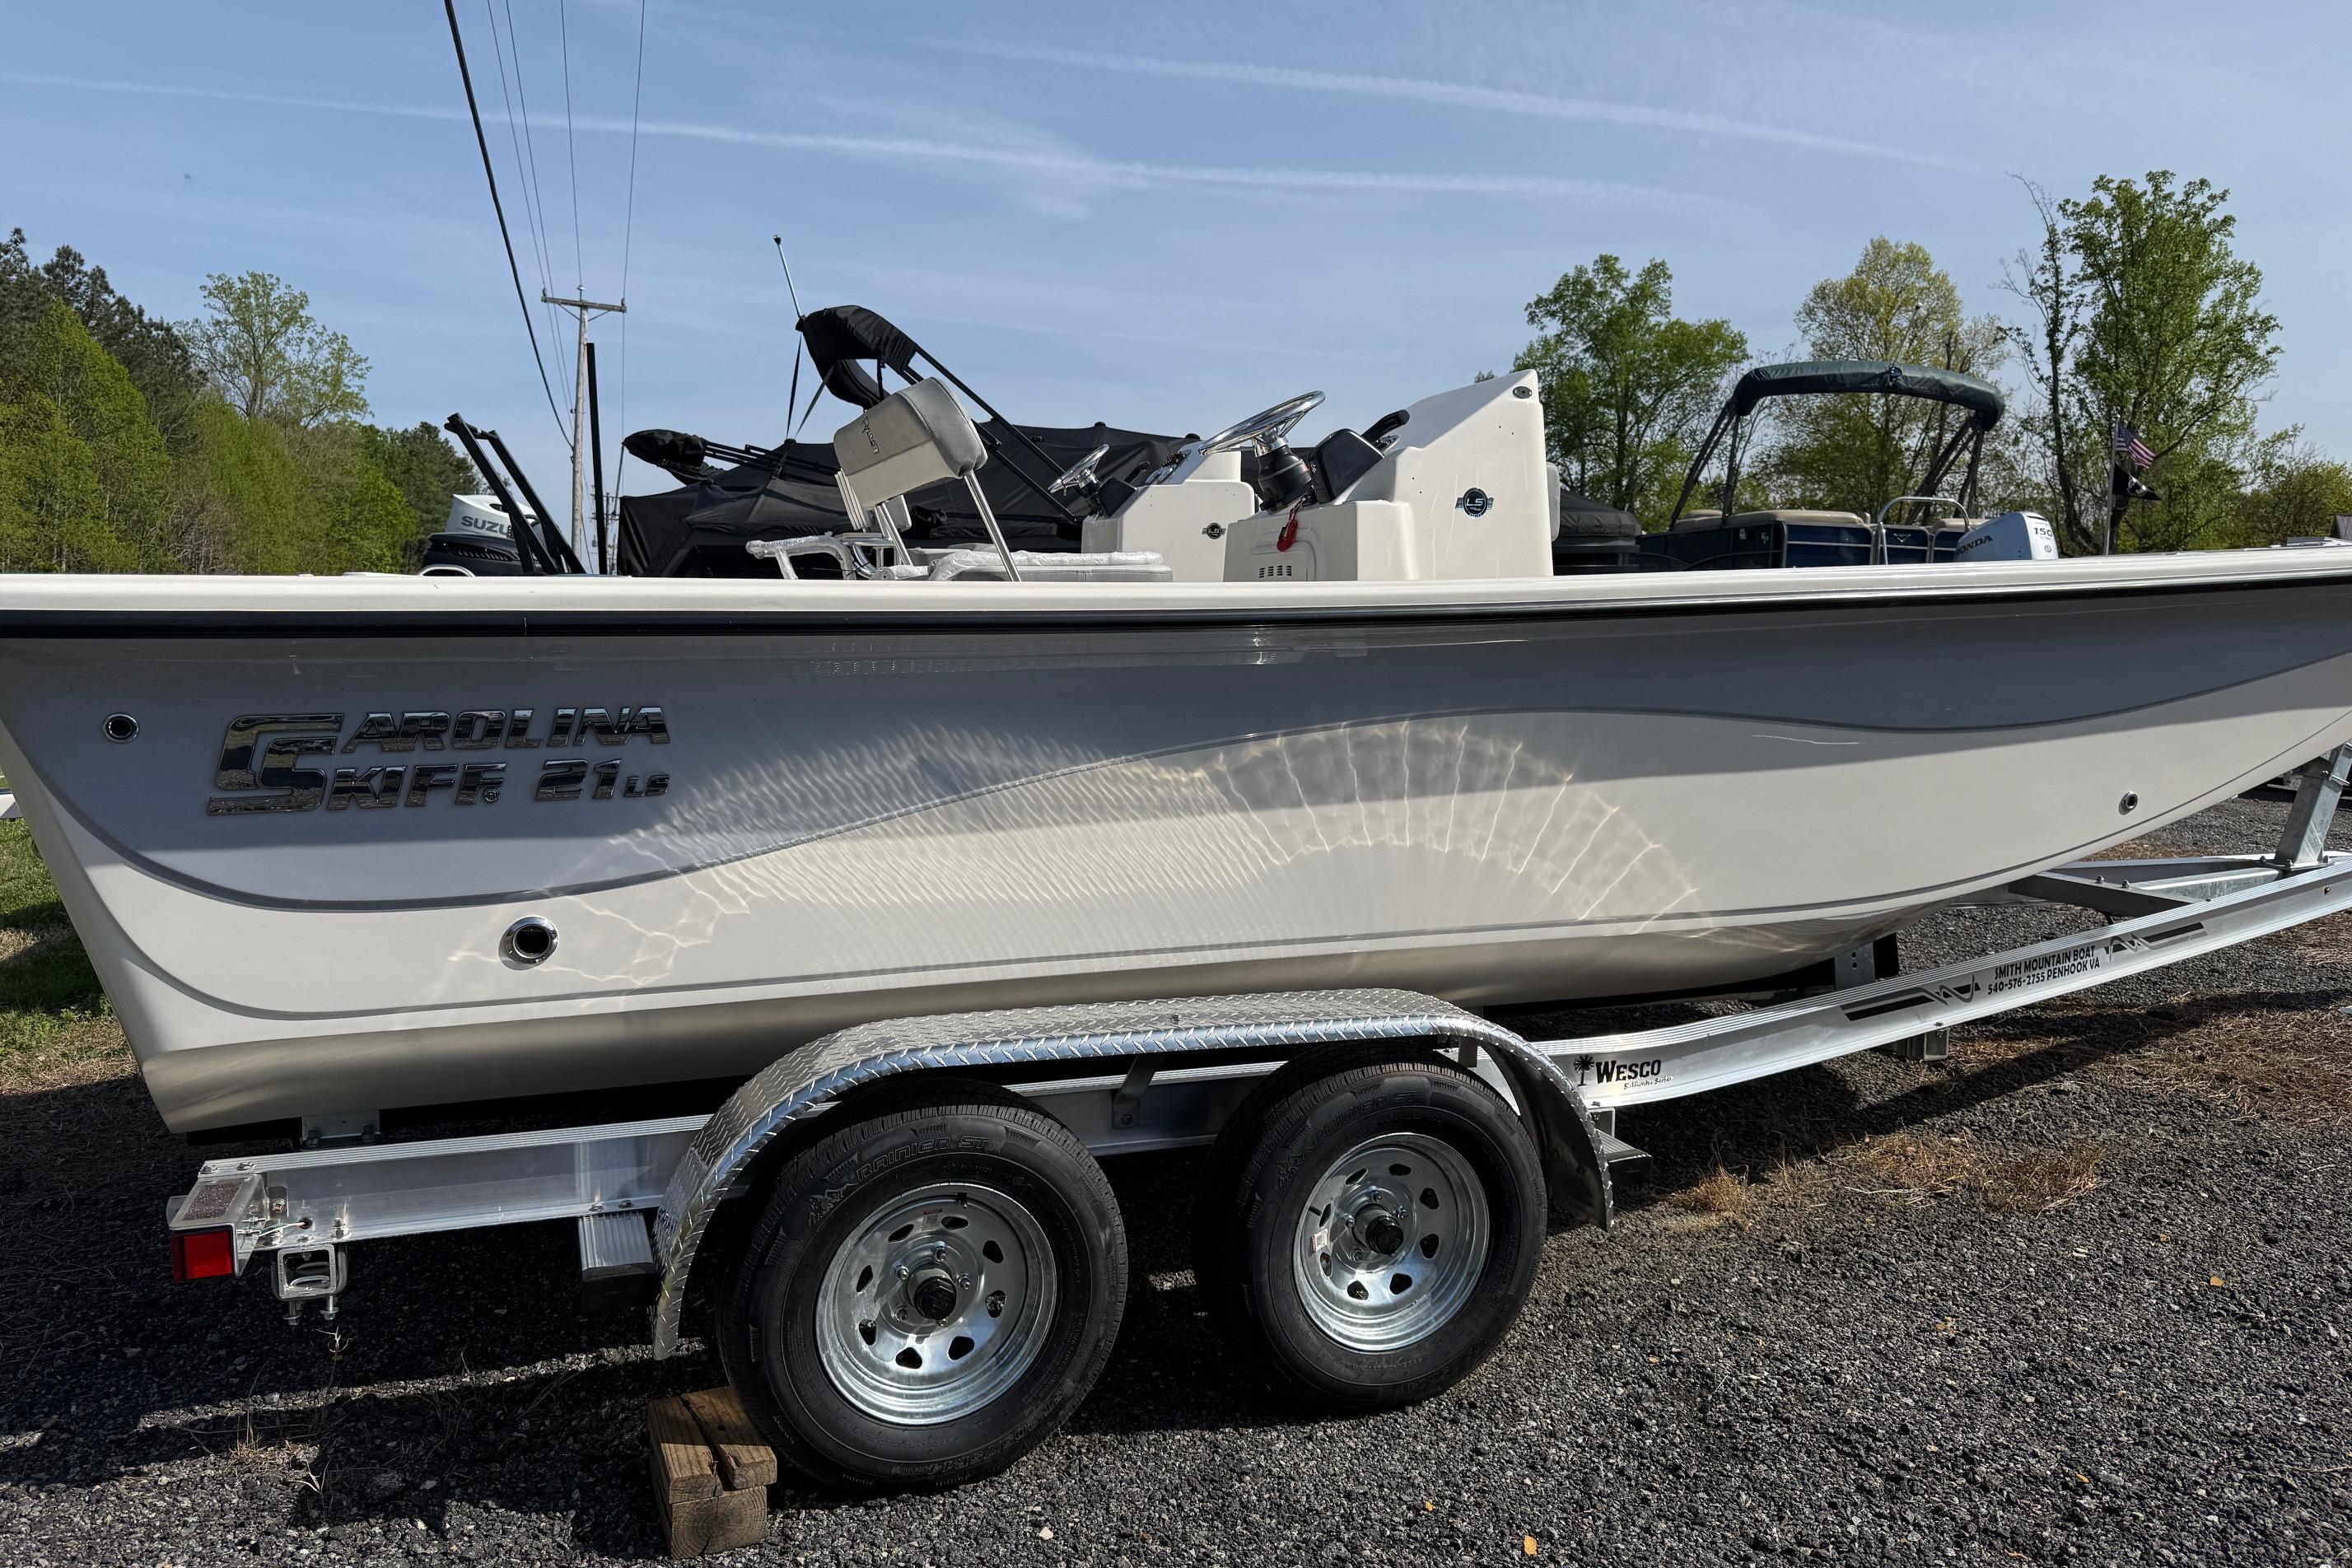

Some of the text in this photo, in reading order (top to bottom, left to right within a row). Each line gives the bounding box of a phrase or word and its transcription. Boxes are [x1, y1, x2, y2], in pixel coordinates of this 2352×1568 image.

[461, 515, 510, 534] SUZU
[2034, 527, 2052, 537] 150
[1987, 957, 2100, 995] 540-576-2755 PENHOOK VA
[1994, 945, 2096, 980] SMITH MOUNTAIN BOAT
[856, 1136, 951, 1183] RAINIER
[958, 1136, 991, 1150] ST
